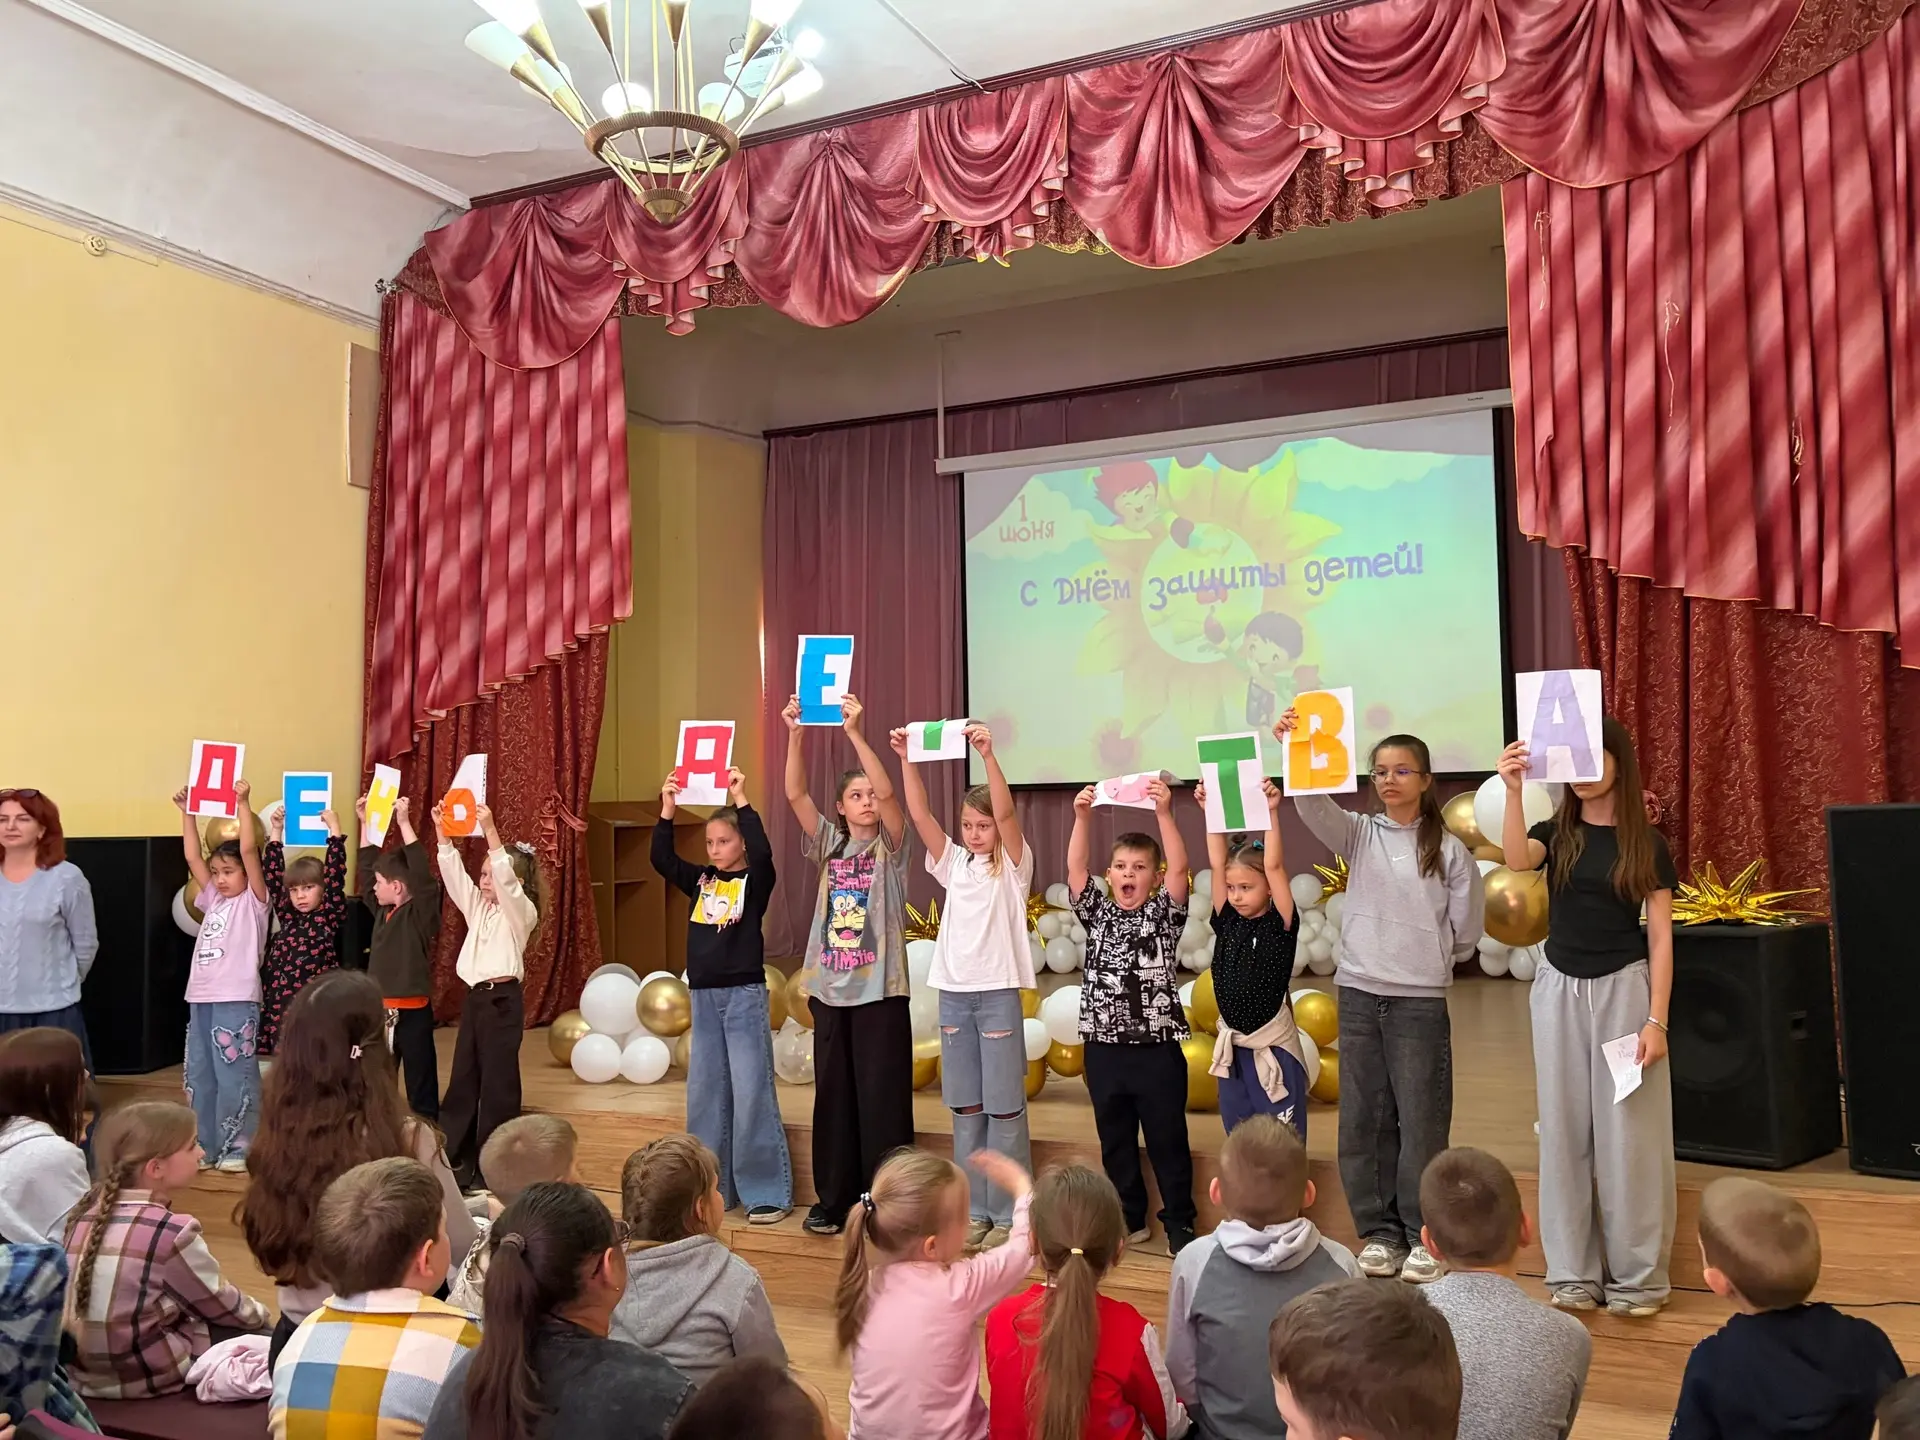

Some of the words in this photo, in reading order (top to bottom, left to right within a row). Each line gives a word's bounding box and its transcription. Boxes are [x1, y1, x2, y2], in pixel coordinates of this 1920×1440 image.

[1017, 493, 1028, 523] 1
[1148, 562, 1287, 611] защиты
[1304, 541, 1425, 597] детей!
